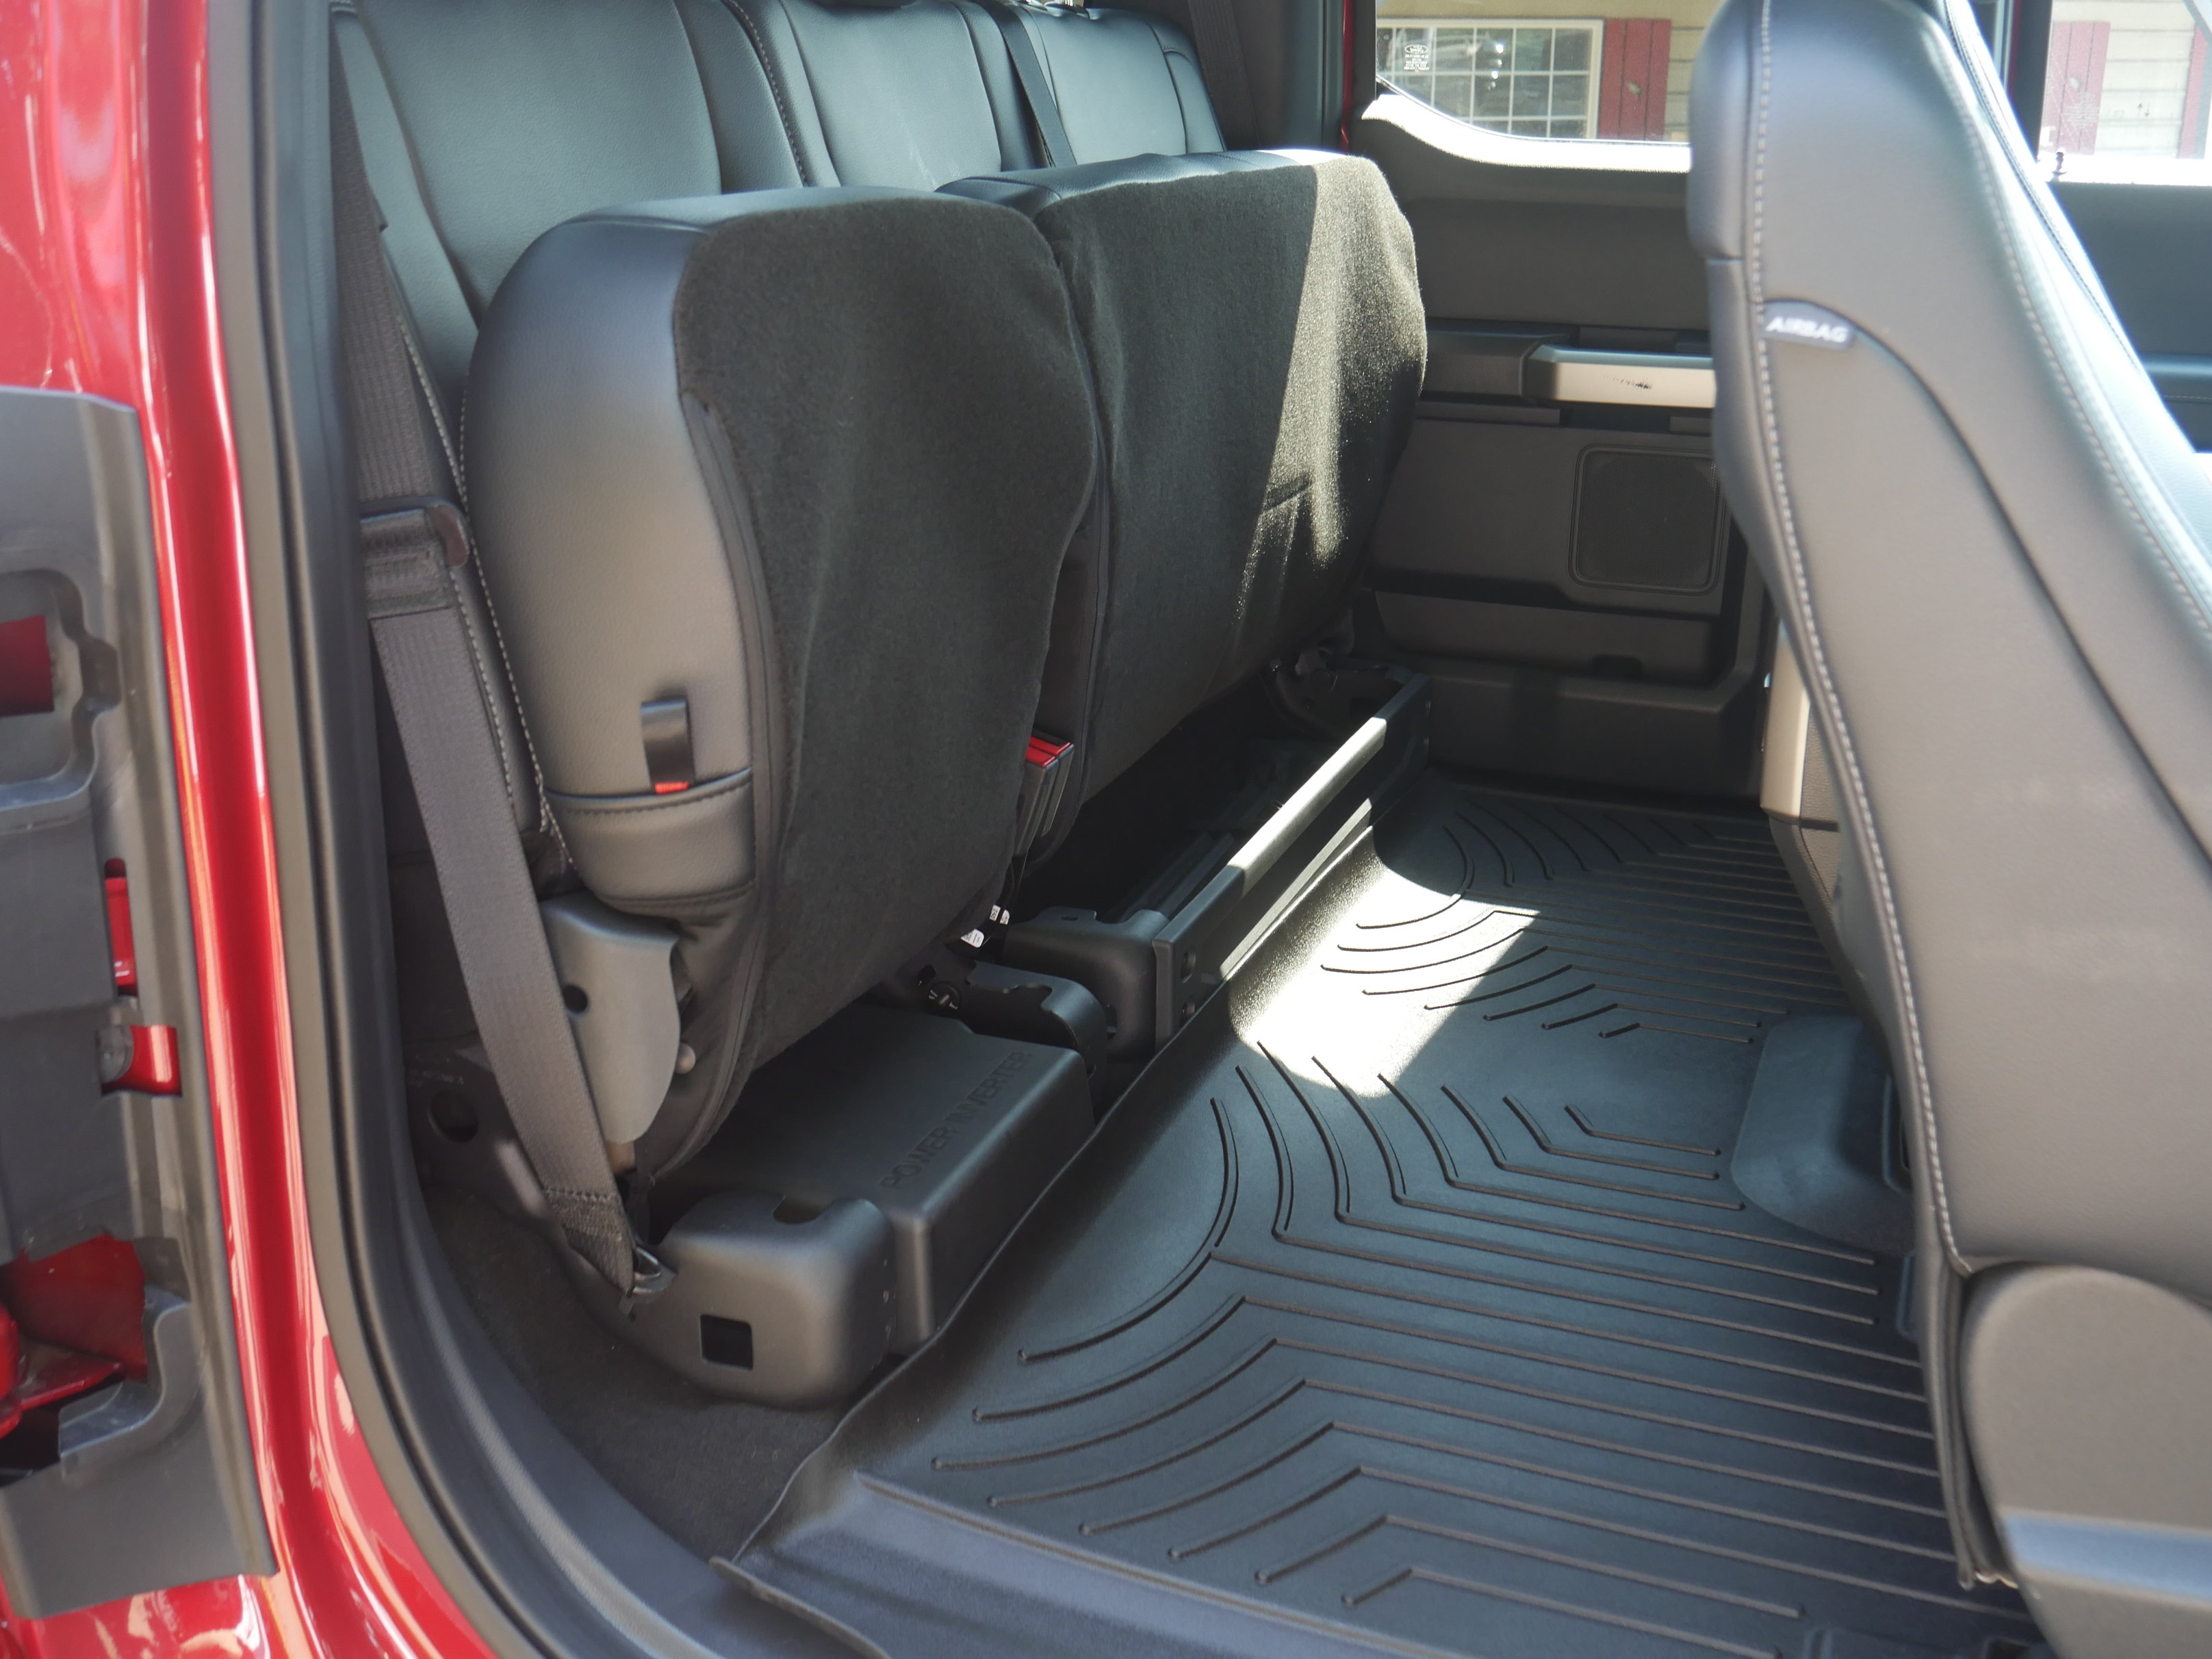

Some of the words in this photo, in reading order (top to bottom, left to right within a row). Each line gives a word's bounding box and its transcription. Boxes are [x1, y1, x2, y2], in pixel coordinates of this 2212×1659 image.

[1765, 316, 1849, 344] AIRBAG
[877, 1127, 958, 1190] POWER
[943, 1051, 1033, 1124] INVERTER
